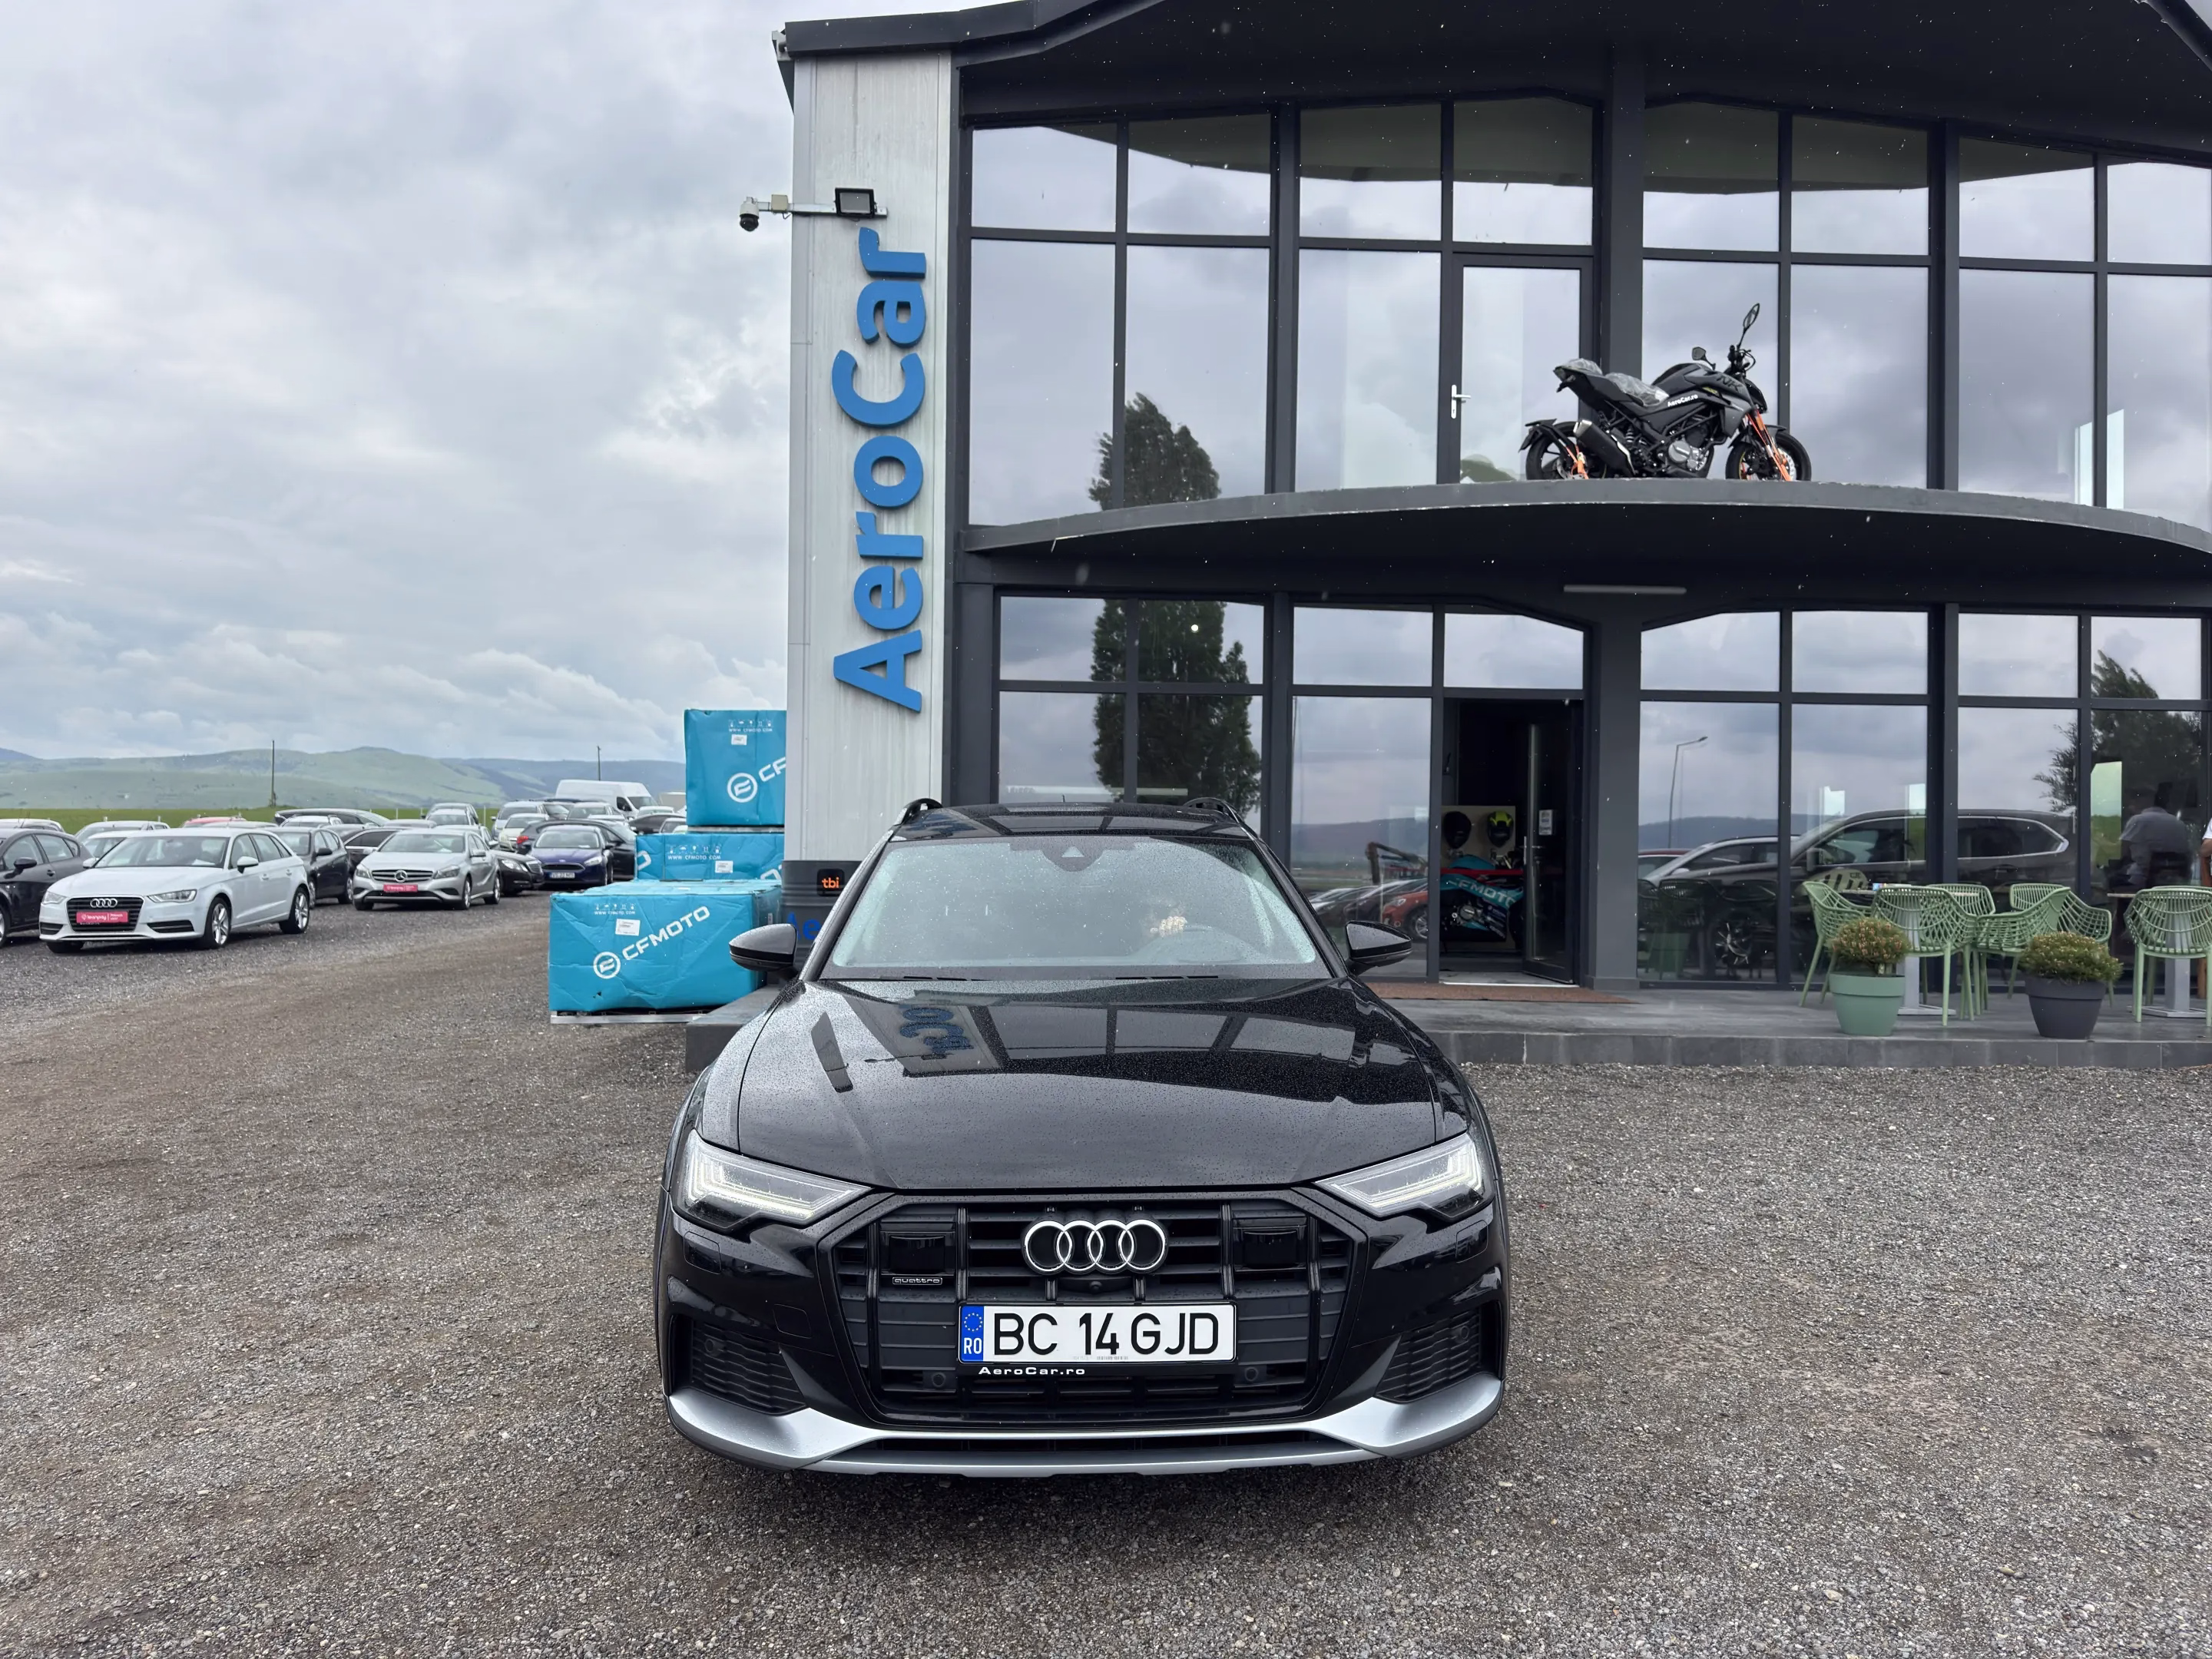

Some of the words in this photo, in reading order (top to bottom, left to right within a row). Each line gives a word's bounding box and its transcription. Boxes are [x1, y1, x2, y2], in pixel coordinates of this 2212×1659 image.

[1667, 394, 1698, 407] AeroCar.ro
[832, 227, 926, 713] AeroCar
[821, 877, 839, 889] tbi
[622, 906, 710, 960] CFMOTO
[963, 1337, 982, 1355] RO
[993, 1313, 1058, 1356] BC
[1079, 1313, 1120, 1356] 14
[1131, 1313, 1220, 1356] GJD
[978, 1366, 1085, 1376] AeroCar.ro
